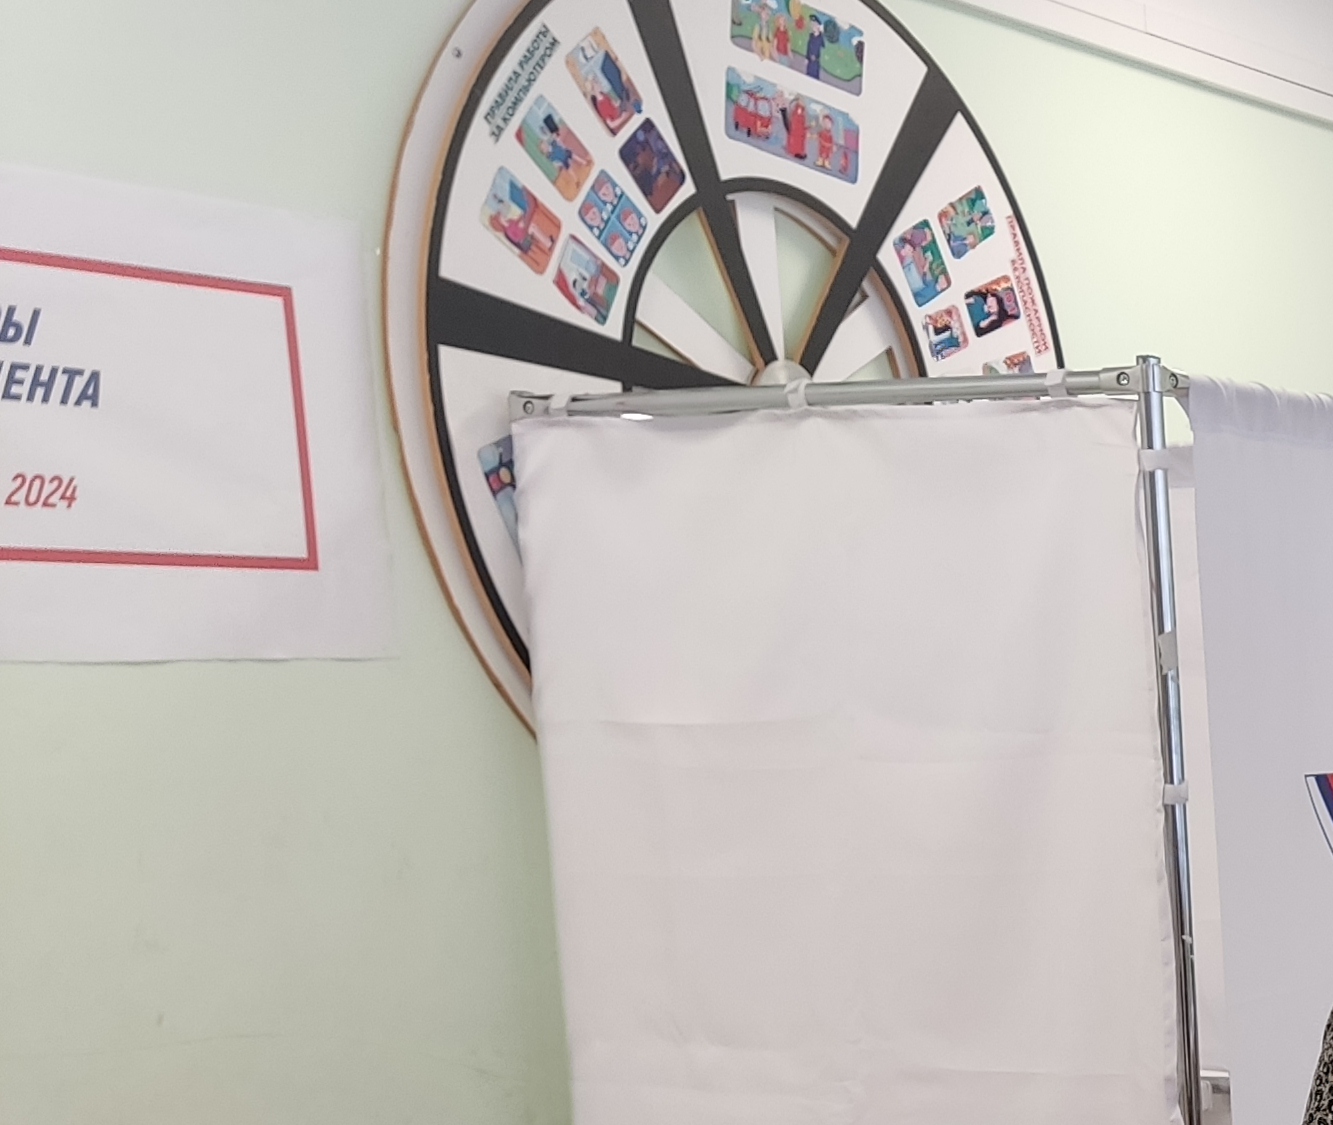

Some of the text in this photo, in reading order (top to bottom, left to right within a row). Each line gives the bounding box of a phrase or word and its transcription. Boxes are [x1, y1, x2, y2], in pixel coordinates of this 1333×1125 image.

[0, 304, 42, 347] Ы
[0, 360, 101, 408] ЕНТА
[4, 472, 78, 509] 2024
